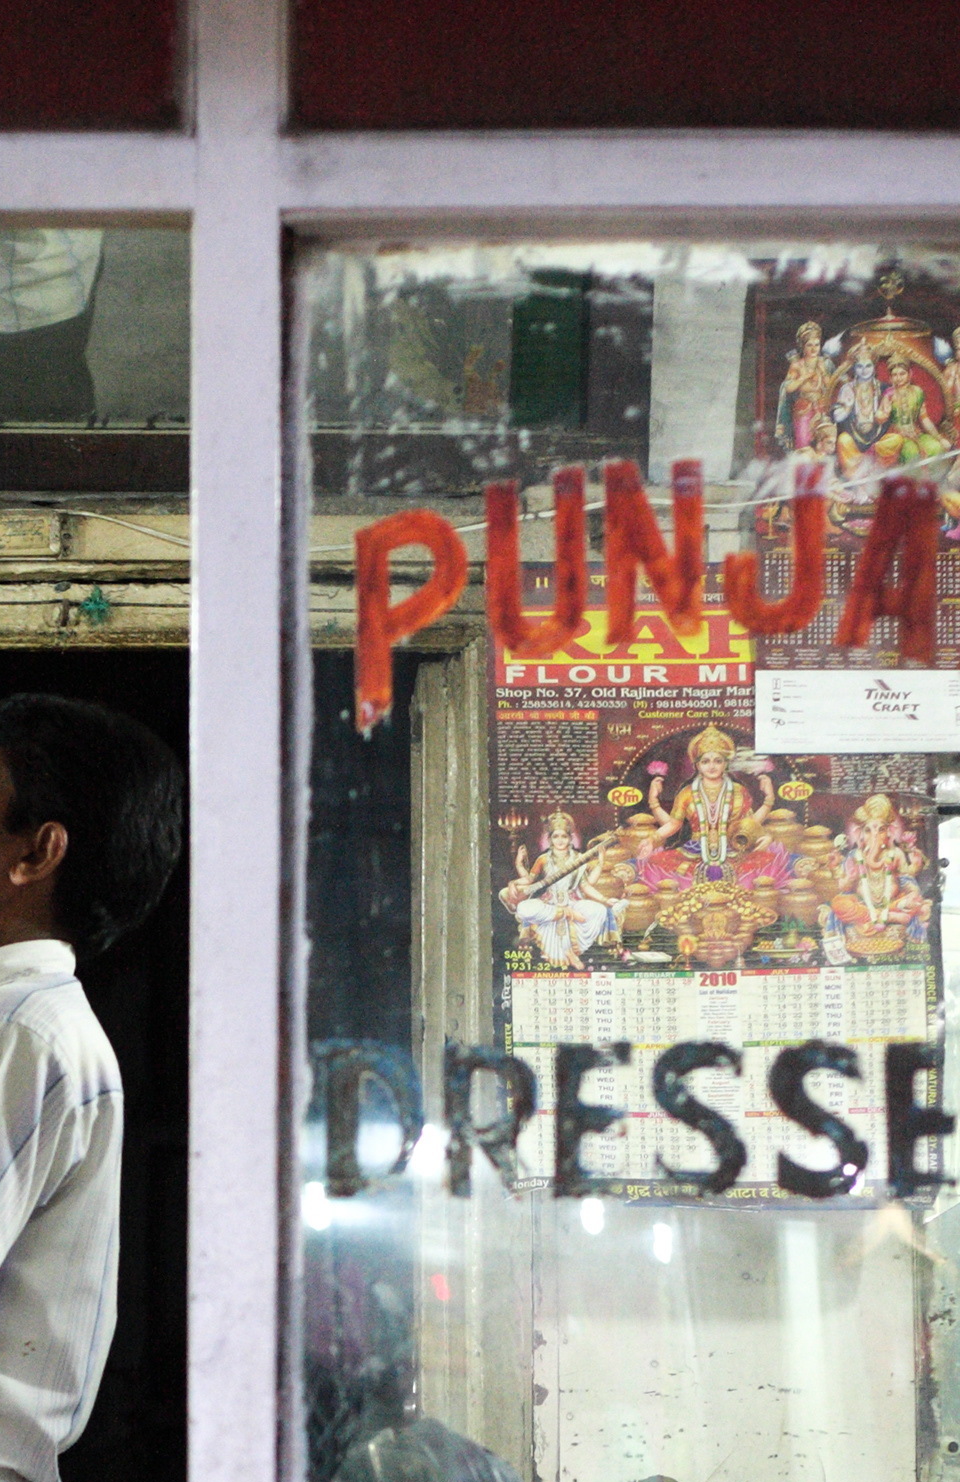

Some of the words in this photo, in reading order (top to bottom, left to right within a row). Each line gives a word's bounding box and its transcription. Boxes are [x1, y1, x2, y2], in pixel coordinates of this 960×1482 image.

[354, 458, 938, 730] PUNJA
[506, 665, 668, 684] FLOUR
[496, 688, 532, 699] Shop
[536, 688, 559, 698] No.
[564, 688, 586, 698] 37,
[591, 688, 616, 698] Old
[620, 687, 678, 699] Rajinder
[682, 687, 722, 699] Nagar
[865, 688, 912, 700] TINNY
[498, 700, 512, 708] Ph.
[633, 700, 648, 709] (M)
[656, 700, 721, 708] 9818540501,
[872, 701, 920, 712] CRAFT
[638, 710, 684, 718] Customer
[686, 710, 708, 718] Care
[733, 709, 754, 717] 258
[504, 950, 532, 959] SAKA
[505, 962, 551, 971] 1931-32
[699, 972, 737, 987] 2010
[926, 965, 937, 1002] SOURCE
